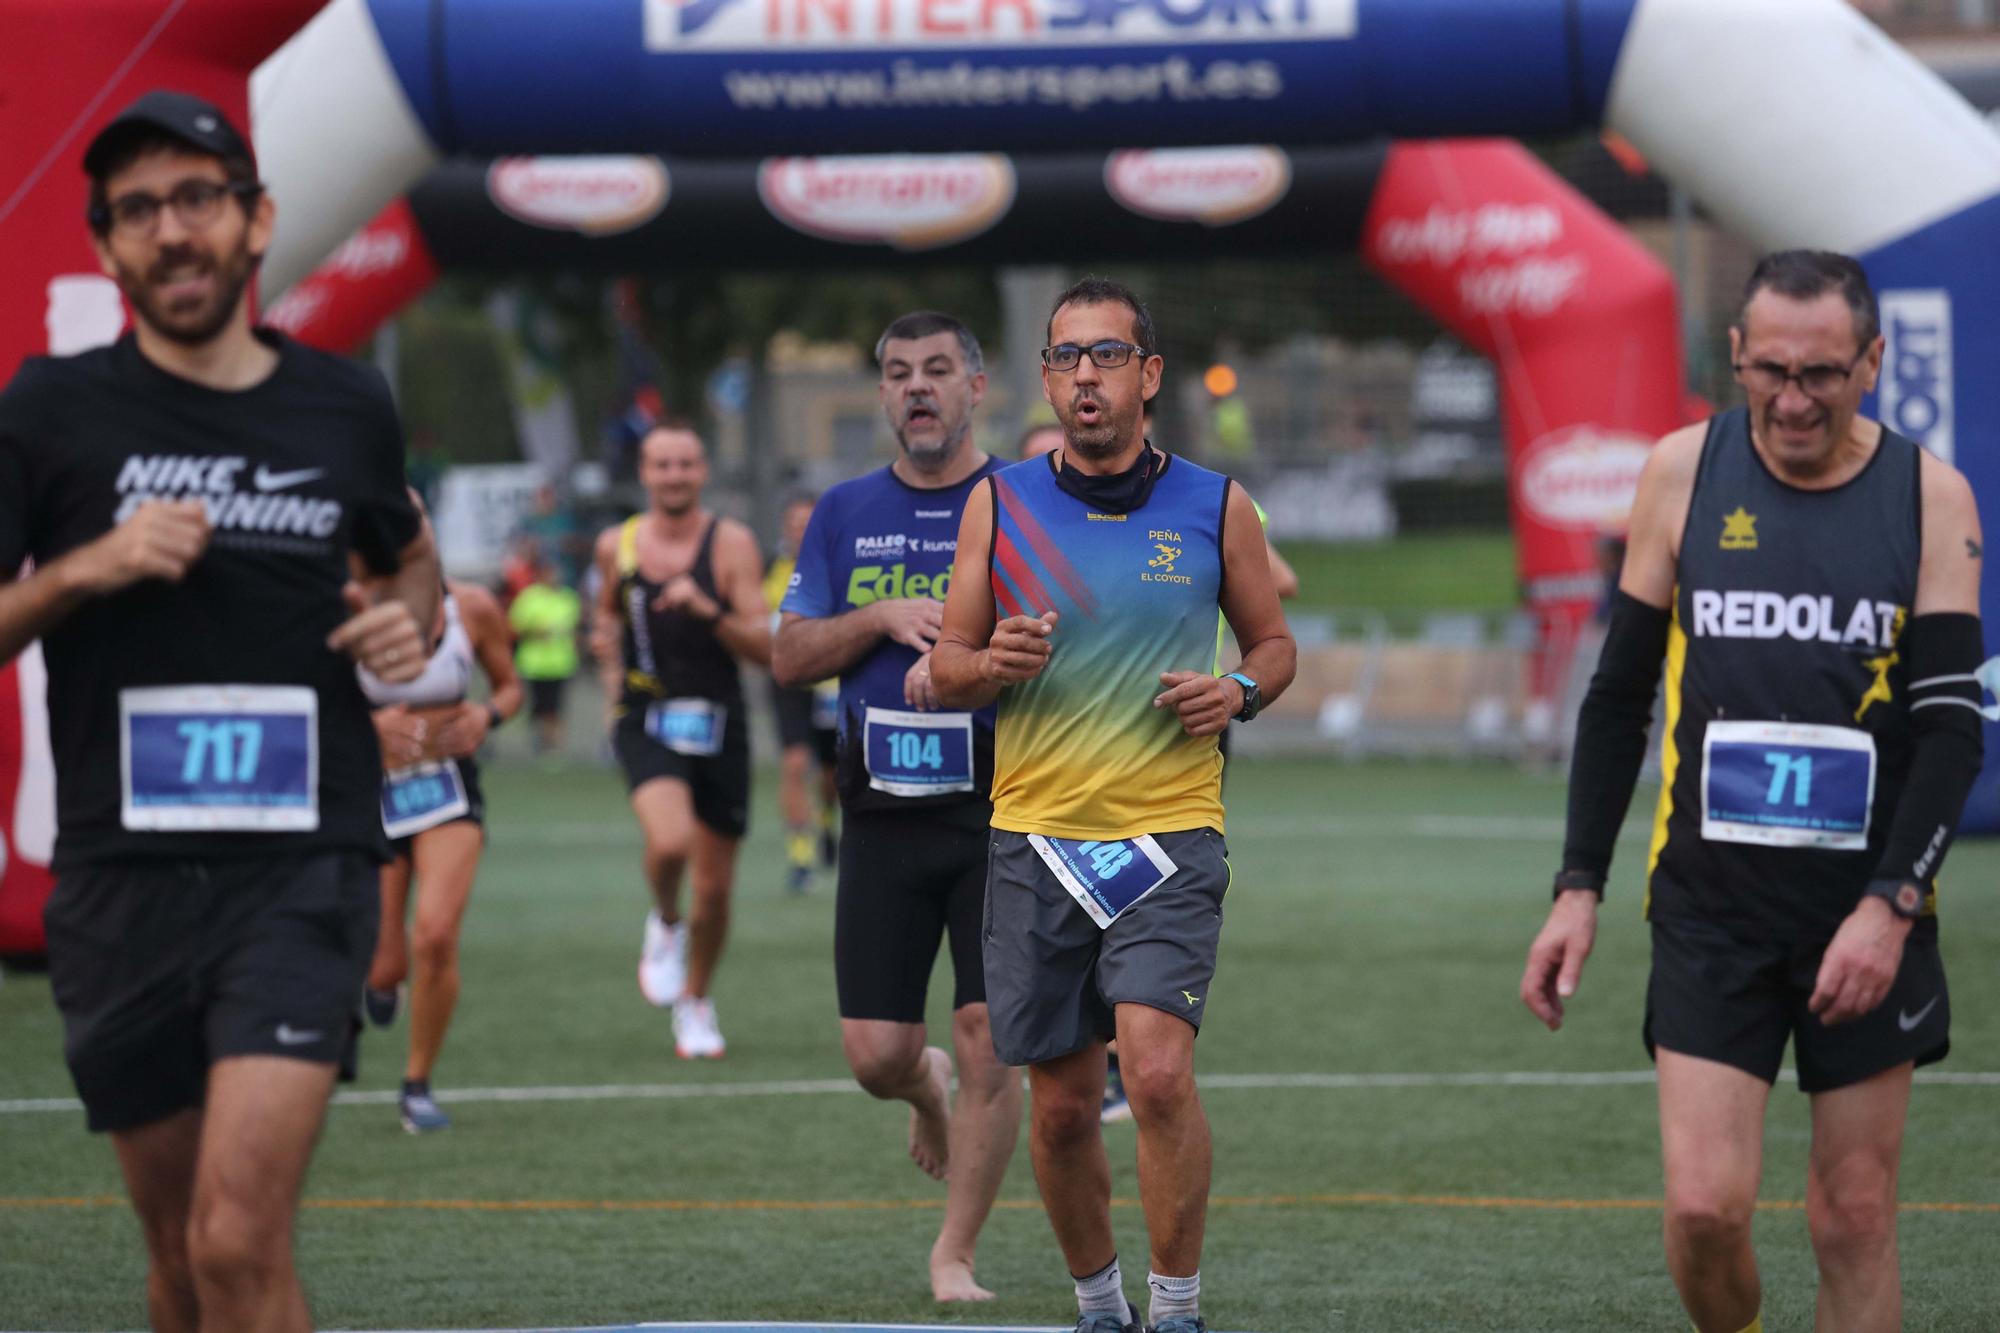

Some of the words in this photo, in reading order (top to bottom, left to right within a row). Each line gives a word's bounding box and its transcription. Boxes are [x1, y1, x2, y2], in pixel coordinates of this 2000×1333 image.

[724, 58, 1280, 109] www.intersport.es
[114, 454, 247, 495] NIKE
[114, 492, 342, 538] NNING
[1148, 529, 1182, 542] PEÑA
[855, 534, 906, 550] PALEO
[1141, 573, 1153, 581] EL
[1154, 573, 1192, 584] COYOTE
[1692, 589, 1895, 648] REDOLAT
[177, 719, 262, 783] 717
[886, 731, 944, 769] 104
[1765, 752, 1812, 807] 71
[1050, 838, 1069, 860] Carrera
[1093, 888, 1117, 917] València
